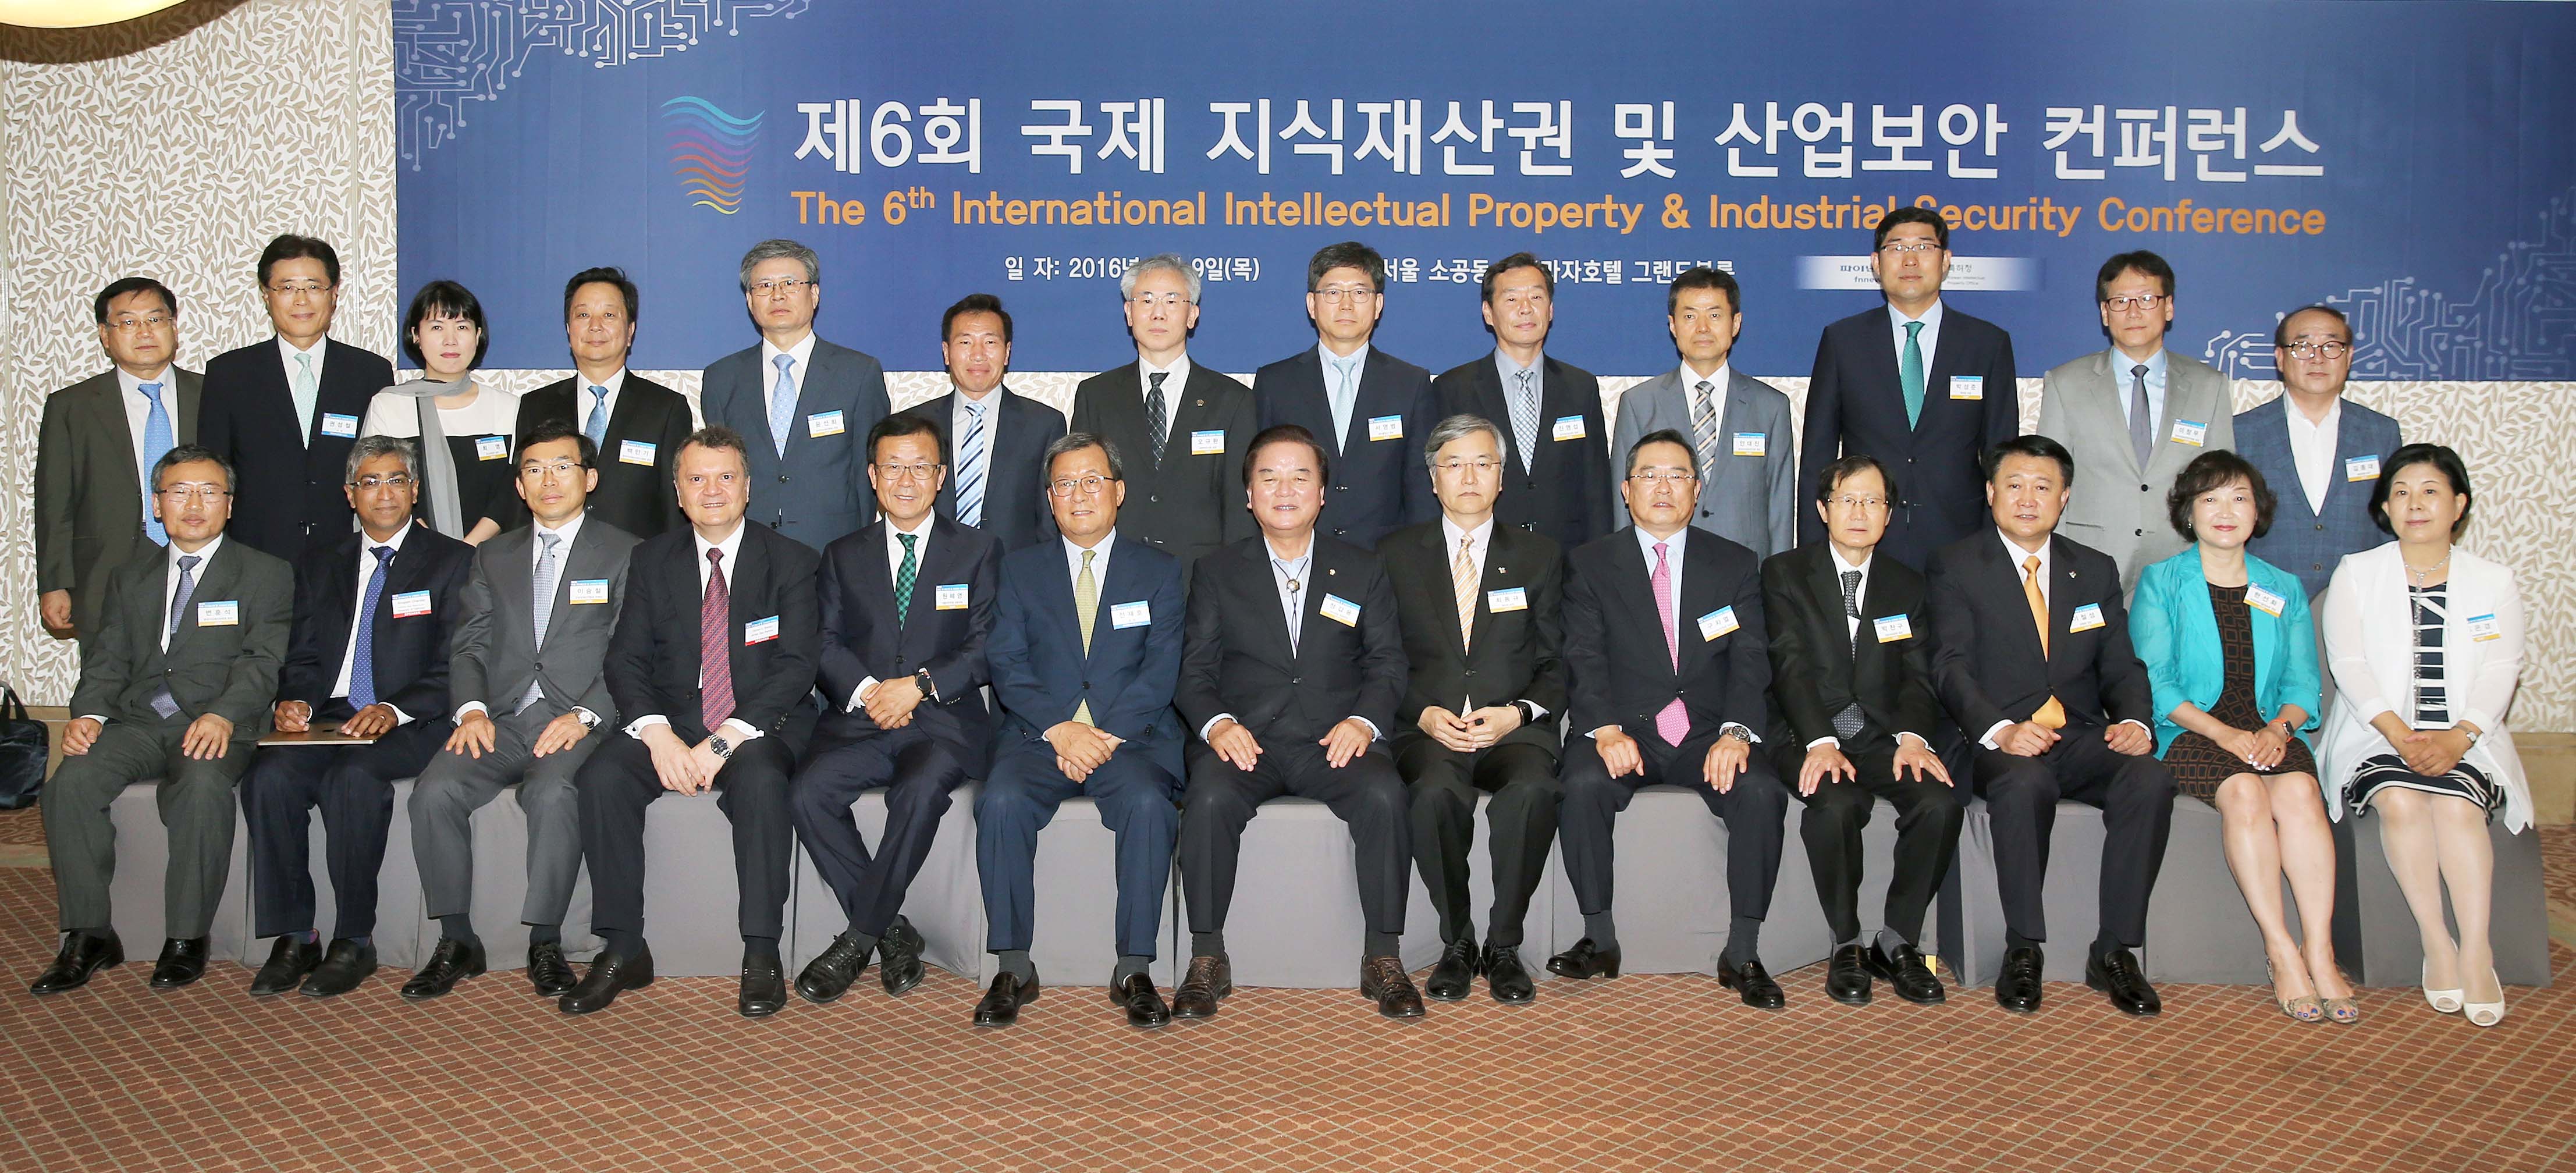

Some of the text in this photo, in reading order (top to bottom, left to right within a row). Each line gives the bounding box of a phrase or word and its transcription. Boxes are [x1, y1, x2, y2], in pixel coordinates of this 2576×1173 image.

[793, 97, 2324, 183] 제6회 국제 지식재산권 및 산업보안 컨퍼런스
[791, 191, 865, 225] The
[883, 186, 936, 225] 6th
[953, 190, 1206, 226] International
[1225, 191, 1450, 228] Intellectual
[1469, 193, 1644, 234] Property
[1661, 193, 1691, 229] &
[2098, 197, 2326, 235] Conference
[1191, 257, 1261, 282] 9일(목)
[1384, 257, 1421, 283] 서울
